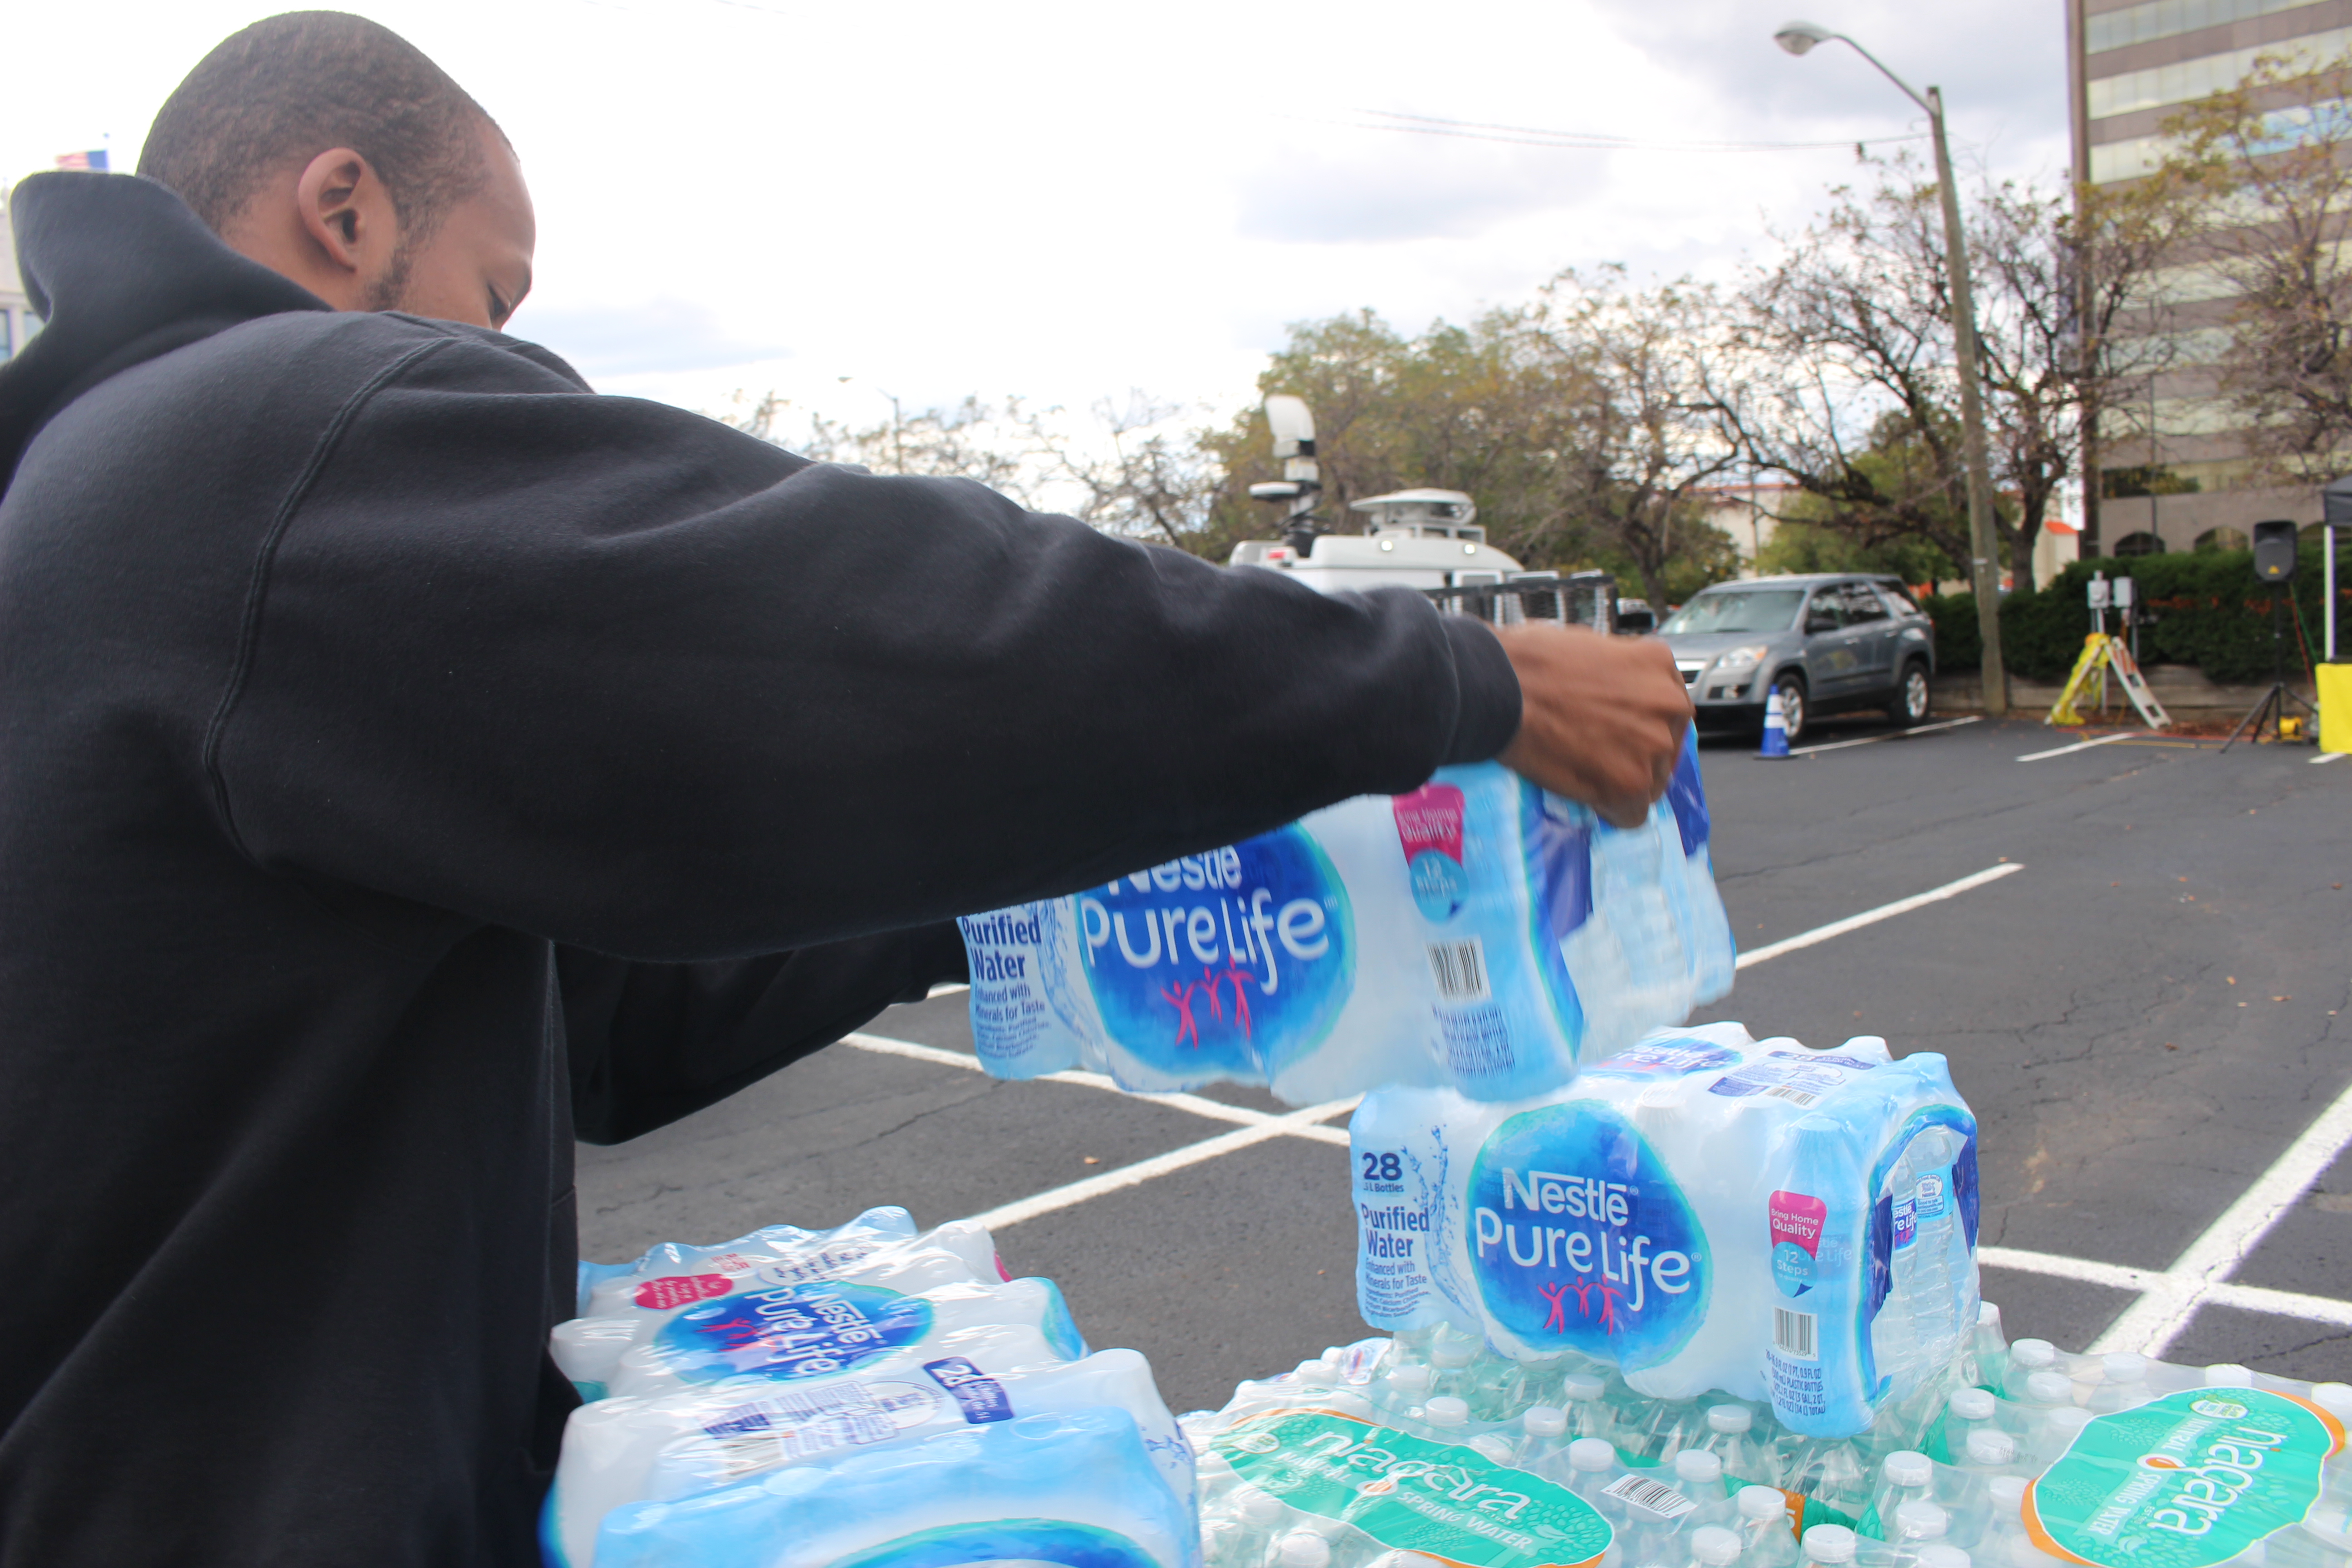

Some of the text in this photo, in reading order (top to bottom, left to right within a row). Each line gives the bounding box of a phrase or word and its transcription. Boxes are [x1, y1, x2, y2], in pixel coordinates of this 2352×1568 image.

[1400, 821, 1457, 844] Quality
[961, 913, 1042, 946] Purified
[1081, 887, 1329, 996] Pure Life
[970, 946, 1026, 981] Water
[1010, 981, 1031, 999] with
[1005, 1004, 1019, 1021] for
[1021, 998, 1046, 1015] Taste
[1362, 1152, 1403, 1181] 28
[1375, 1183, 1404, 1193] Bottles
[1361, 1202, 1430, 1232] Purified
[1771, 1208, 1819, 1225] Bring Home
[1894, 1200, 1914, 1219] estlé
[1772, 1218, 1817, 1240] Quality
[1366, 1228, 1413, 1258] Water
[1397, 1260, 1415, 1274] with
[1475, 1206, 1691, 1312] Pure Life
[1776, 1259, 1808, 1276] Steps
[1784, 1249, 1799, 1264] 12
[1827, 1247, 1852, 1268] Life
[1392, 1278, 1404, 1289] for
[1405, 1274, 1427, 1287] Taste
[743, 1288, 819, 1333] Pure
[765, 1333, 845, 1375] Life
[1804, 1380, 1823, 1392] BOTTLES
[1303, 1431, 1531, 1520] niagara
[2087, 1418, 2213, 1535] NATURAL SPRING WATER
[2146, 1427, 2288, 1535] niagara
[1276, 1452, 1534, 1549] NATURAL SPRING WATER
